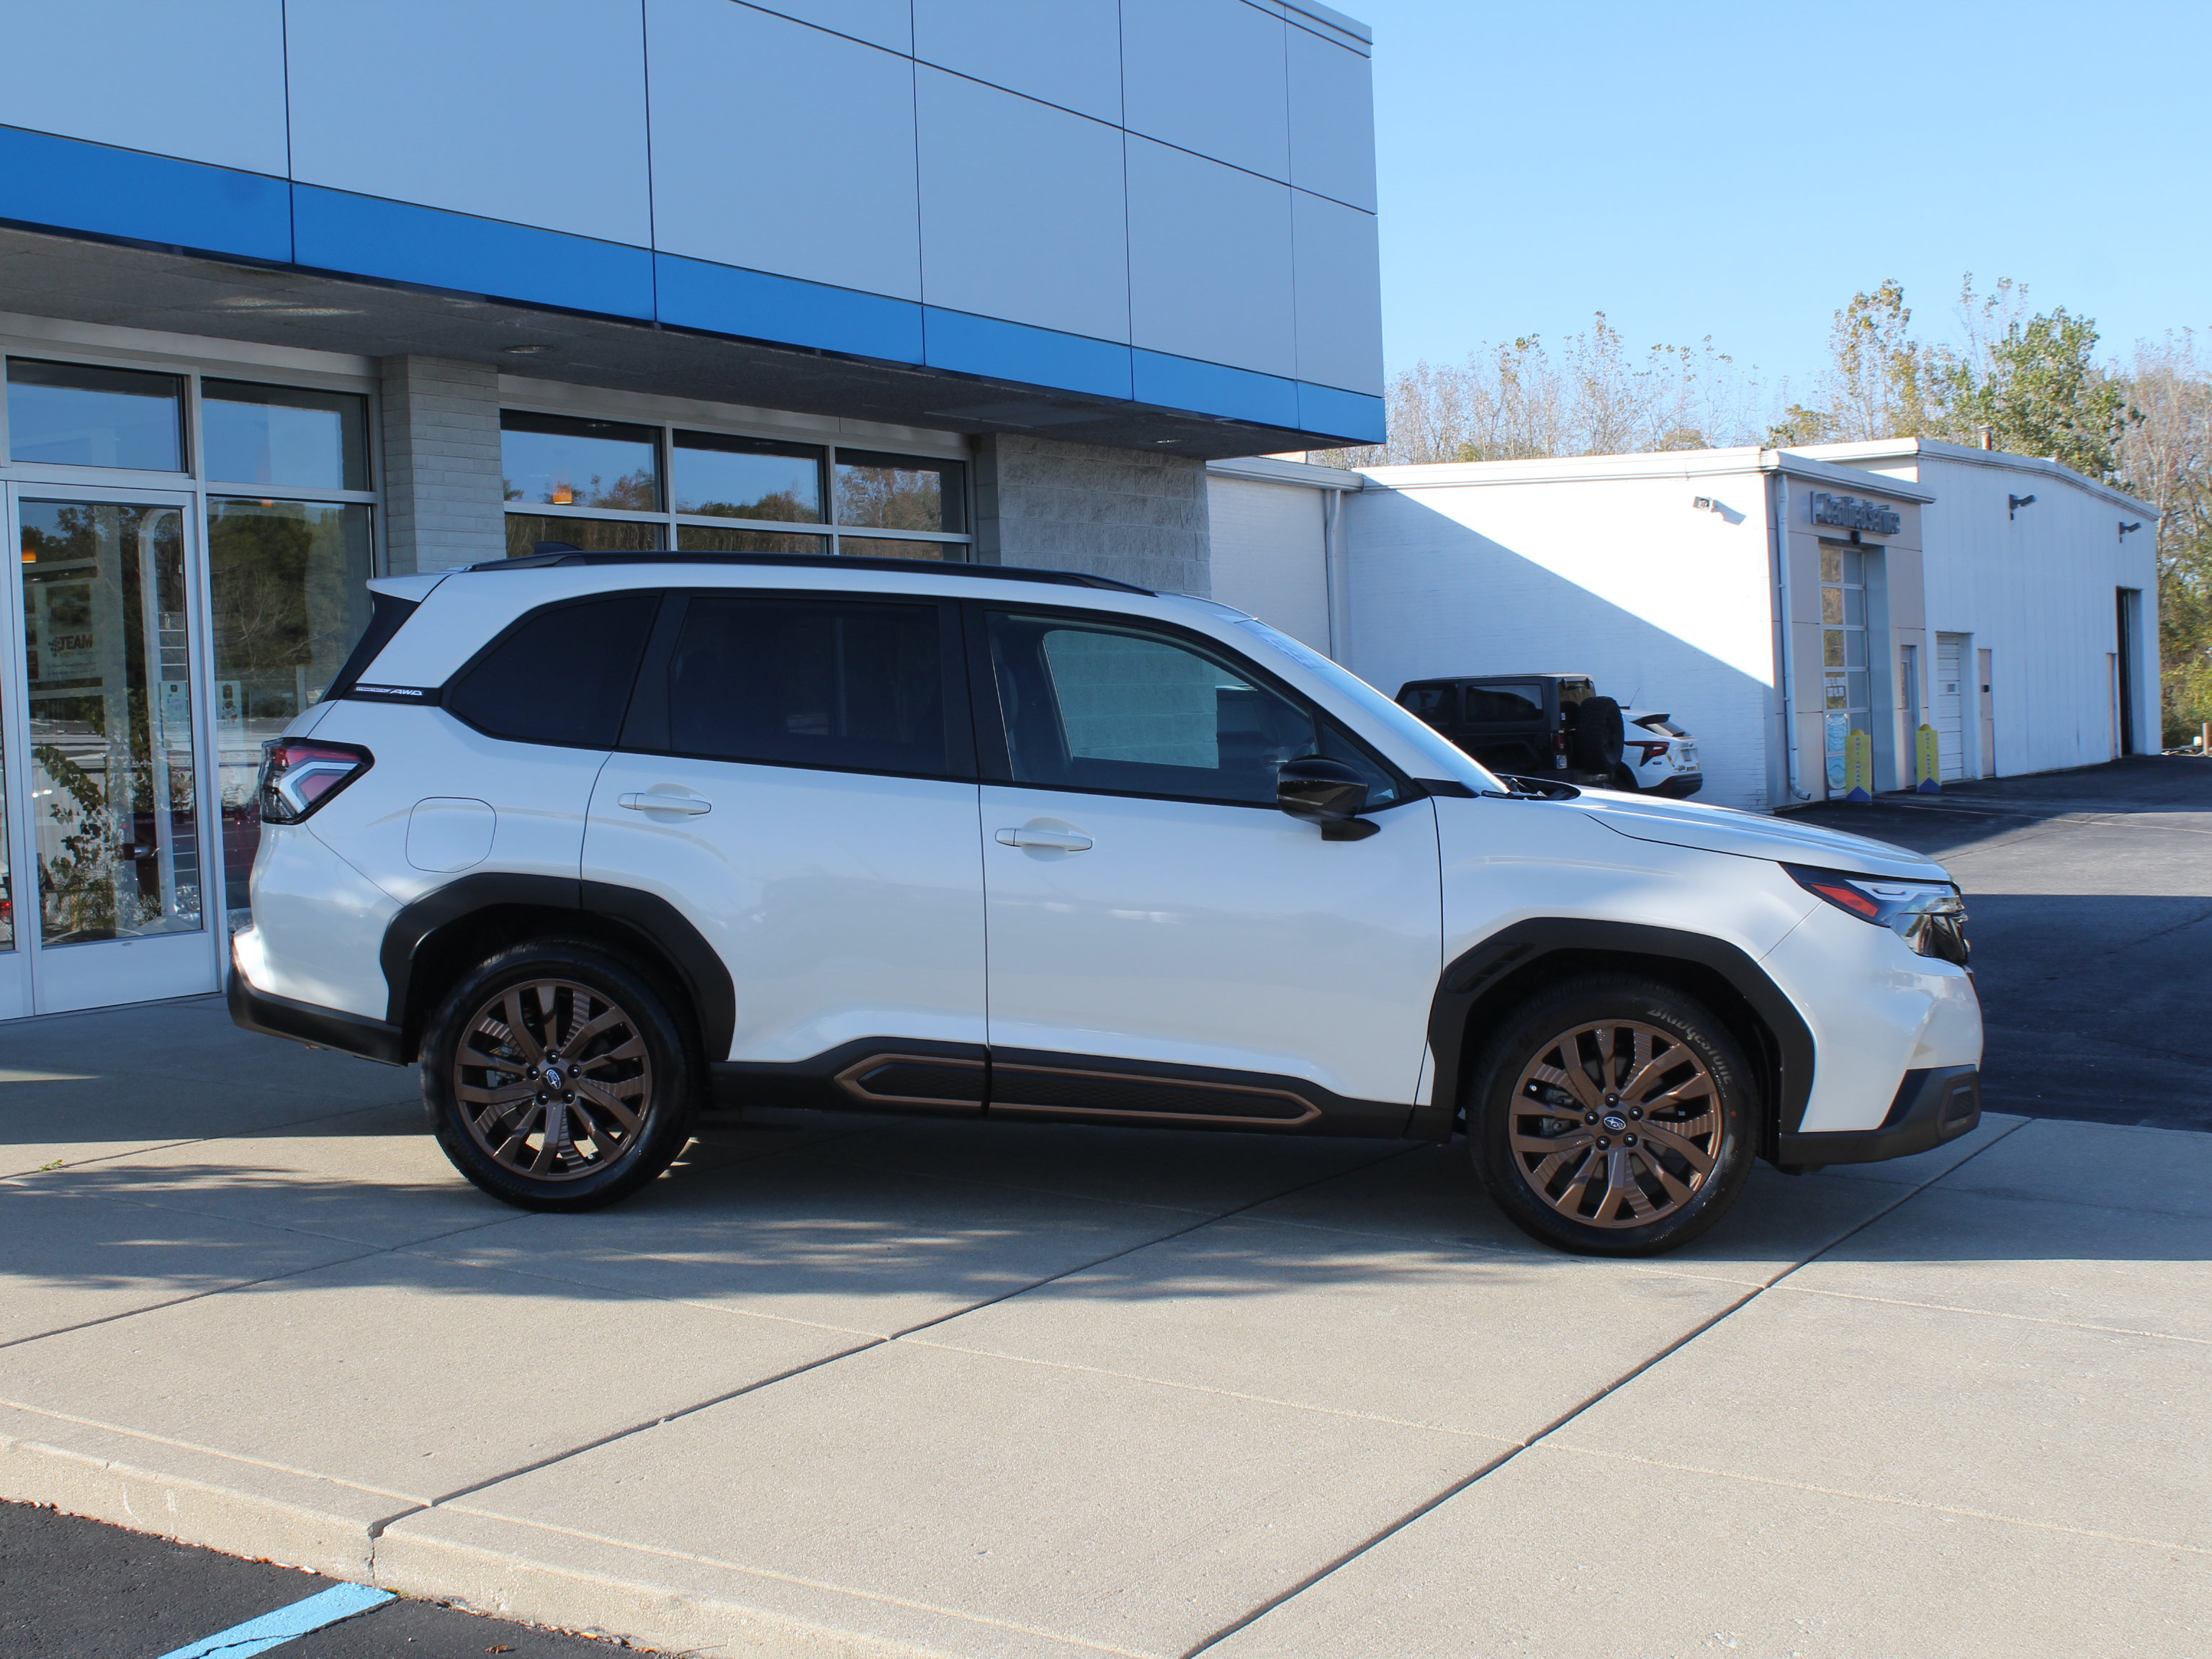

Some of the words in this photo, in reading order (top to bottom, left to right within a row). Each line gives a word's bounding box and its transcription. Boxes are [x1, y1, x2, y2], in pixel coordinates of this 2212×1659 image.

[1815, 493, 1866, 529] Certified
[1865, 501, 1901, 534] Service
[59, 634, 93, 651] TEAM
